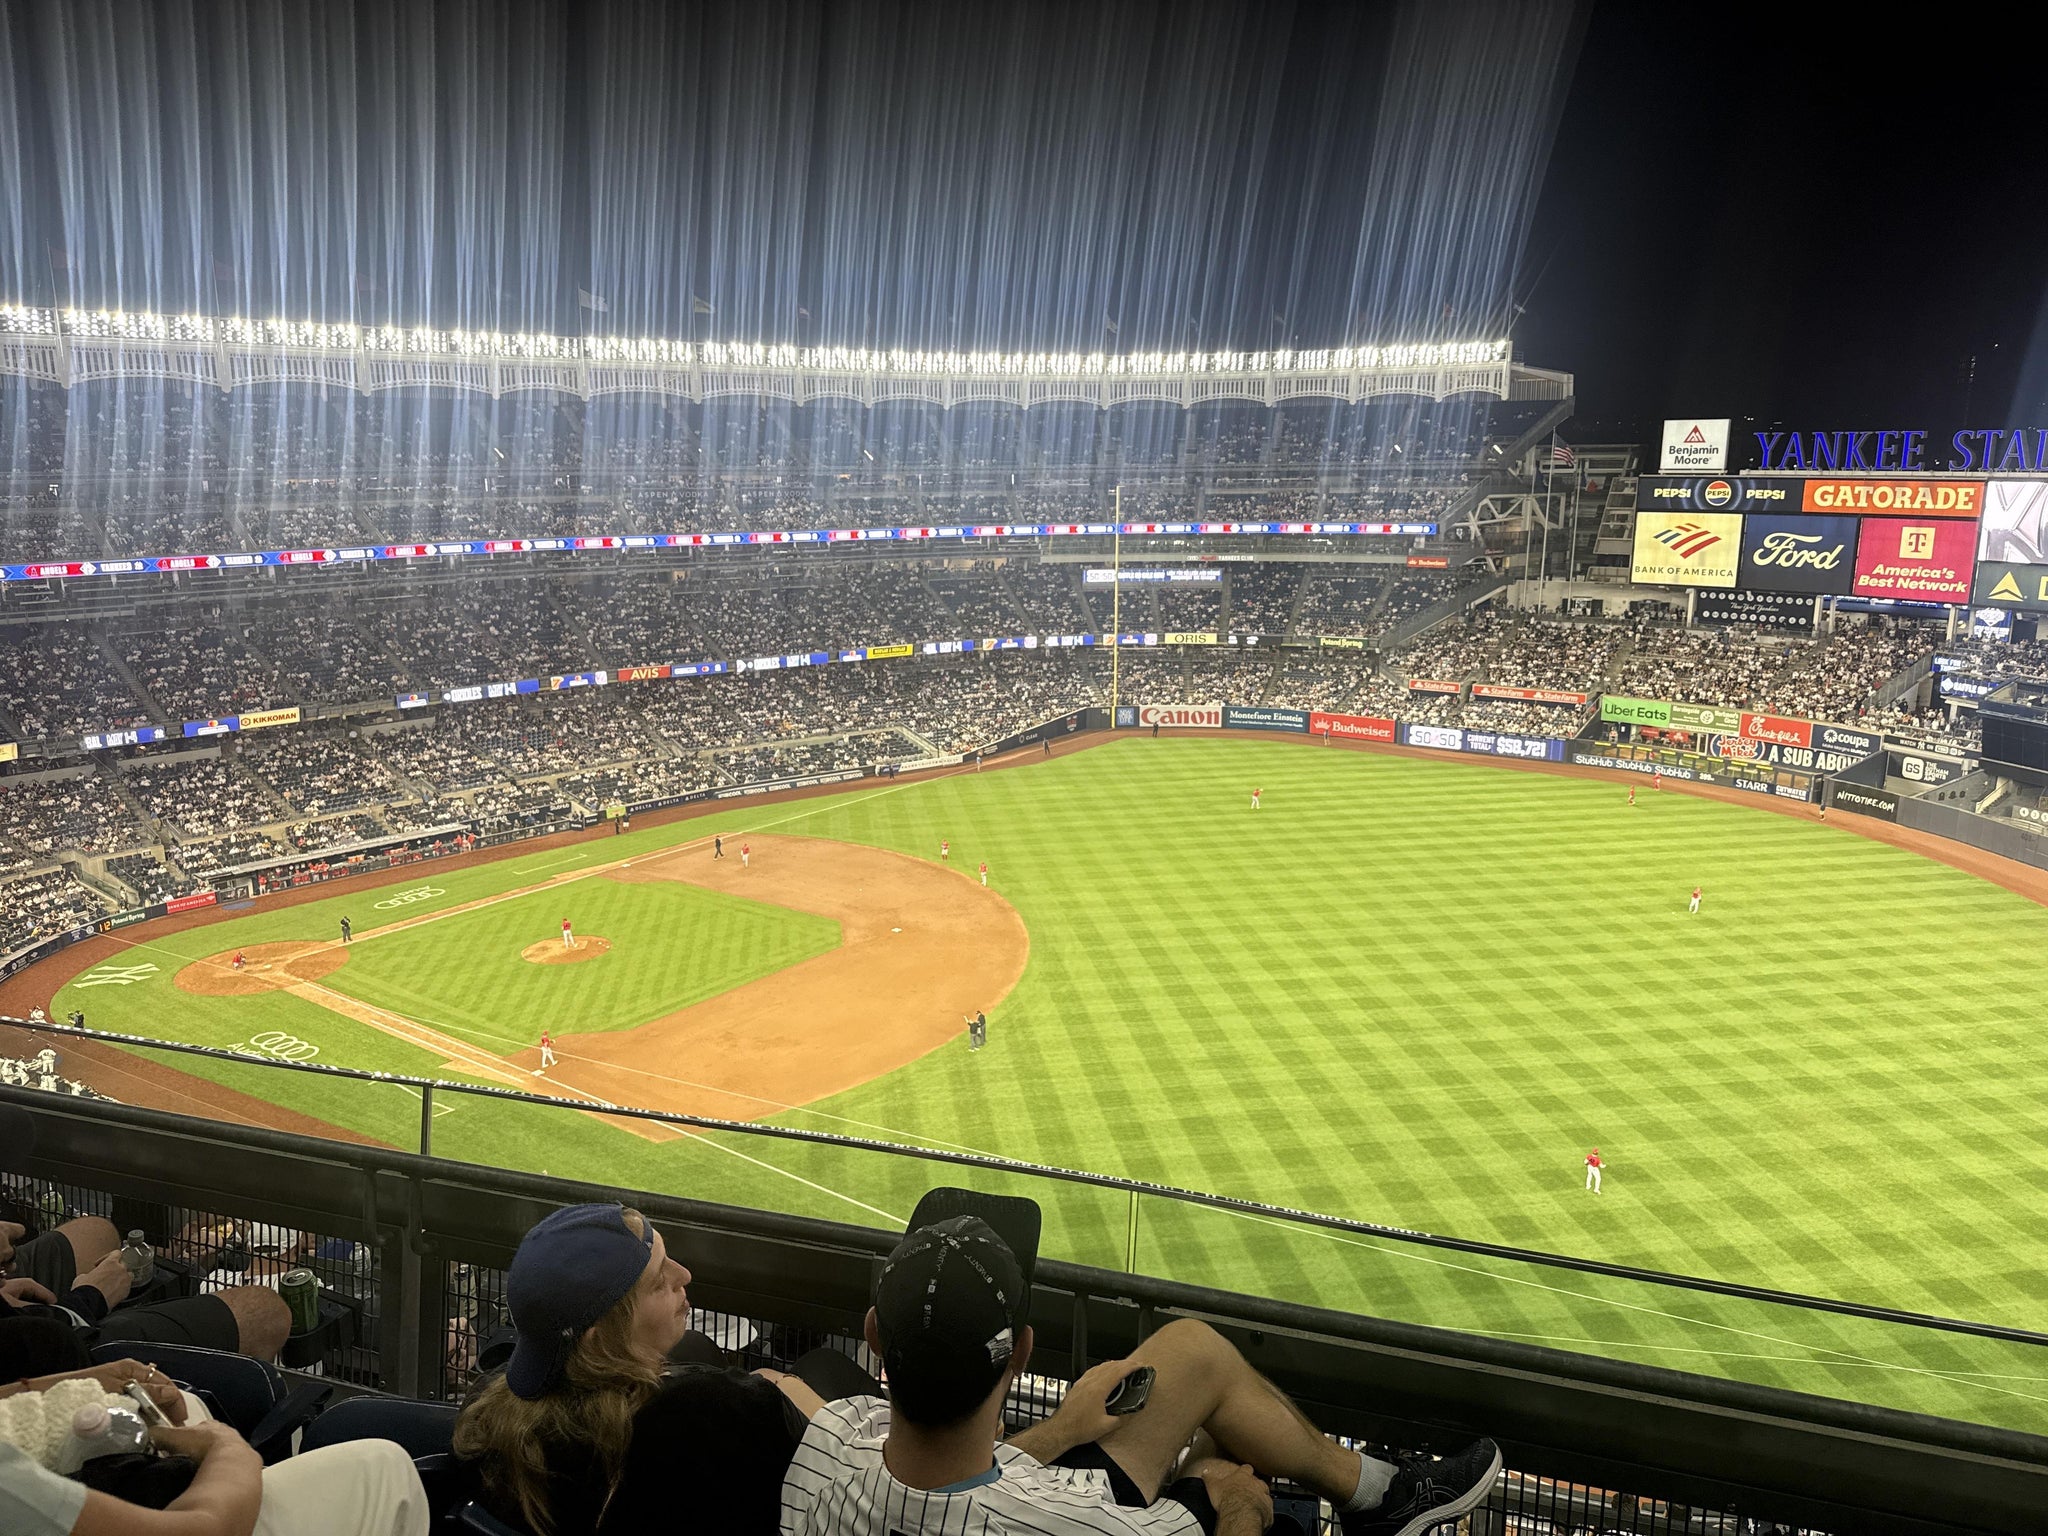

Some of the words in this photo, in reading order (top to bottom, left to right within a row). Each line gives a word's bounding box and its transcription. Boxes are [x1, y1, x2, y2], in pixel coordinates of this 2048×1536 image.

[1669, 445, 1719, 456] Benjamin
[1752, 430, 1926, 471] YANKEE
[1674, 455, 1709, 465] Moore
[1654, 488, 1691, 498] PEPSI
[1746, 489, 1785, 500] PEPSI
[1813, 485, 1975, 510] GATORADE
[1753, 532, 1844, 570] Ford
[1634, 566, 1665, 574] BANK
[1667, 567, 1681, 575] OF
[1684, 568, 1734, 577] AMERICA
[1872, 563, 1955, 579] America's
[1858, 575, 1894, 588] Best
[1895, 577, 1968, 593] Network
[1175, 635, 1206, 643] ORIS
[1320, 637, 1341, 647] Poland
[1341, 638, 1363, 648] Spring
[630, 667, 659, 679] AVIS
[1423, 682, 1439, 690] State
[1439, 683, 1456, 692] Farm
[253, 713, 297, 724] KIKKOMAN
[1141, 707, 1220, 725] Canon
[1229, 710, 1271, 722] Montefiore
[1273, 712, 1304, 723] Einstein
[1605, 703, 1635, 717] Uber
[1637, 707, 1667, 721] Eats
[1332, 721, 1391, 738] Budweiser
[1467, 734, 1496, 745] CURRENT
[1497, 736, 1546, 757] $58,721
[1719, 735, 1757, 749] Jersey
[1837, 733, 1869, 748] coupa
[1768, 745, 1779, 762] A
[1783, 746, 1813, 766] SUB
[1815, 751, 1862, 772] ABOV
[1575, 755, 1613, 768] StubHub
[1616, 760, 1652, 774] StubHub
[1654, 765, 1691, 780] StubHub
[1905, 763, 1921, 775] GS
[1735, 778, 1768, 793] STARR
[1836, 790, 1895, 813] NITTOTIRE.COM
